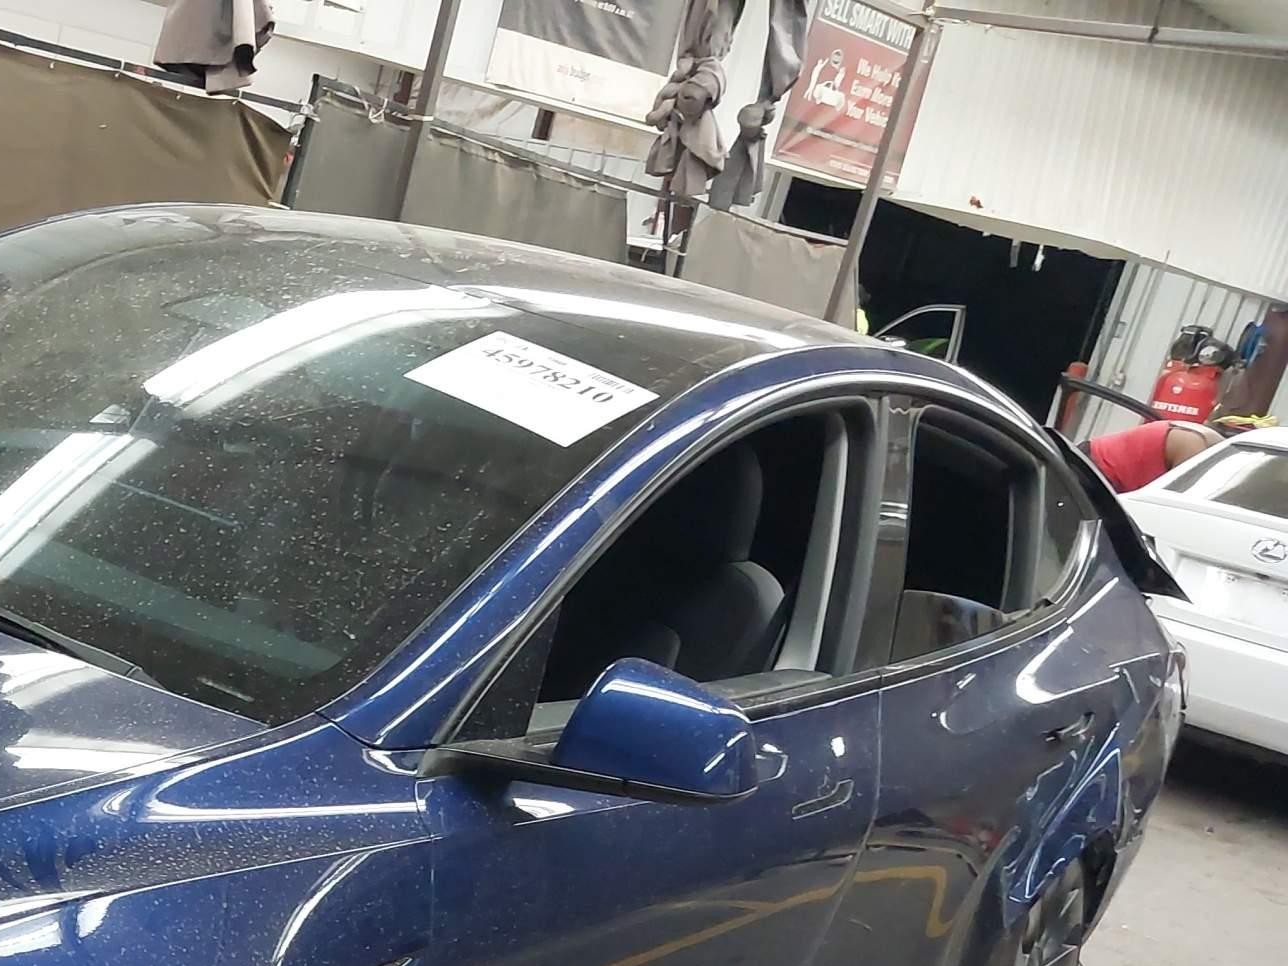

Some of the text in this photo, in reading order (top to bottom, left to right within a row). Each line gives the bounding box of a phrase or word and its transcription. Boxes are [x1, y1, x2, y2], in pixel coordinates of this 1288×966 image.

[823, 0, 852, 24] SELL
[849, 3, 890, 38] SMART
[886, 18, 917, 50] WITH
[864, 106, 889, 128] Vehic
[482, 349, 614, 403] 45978210
[1152, 401, 1200, 416] RAFTSMAN
